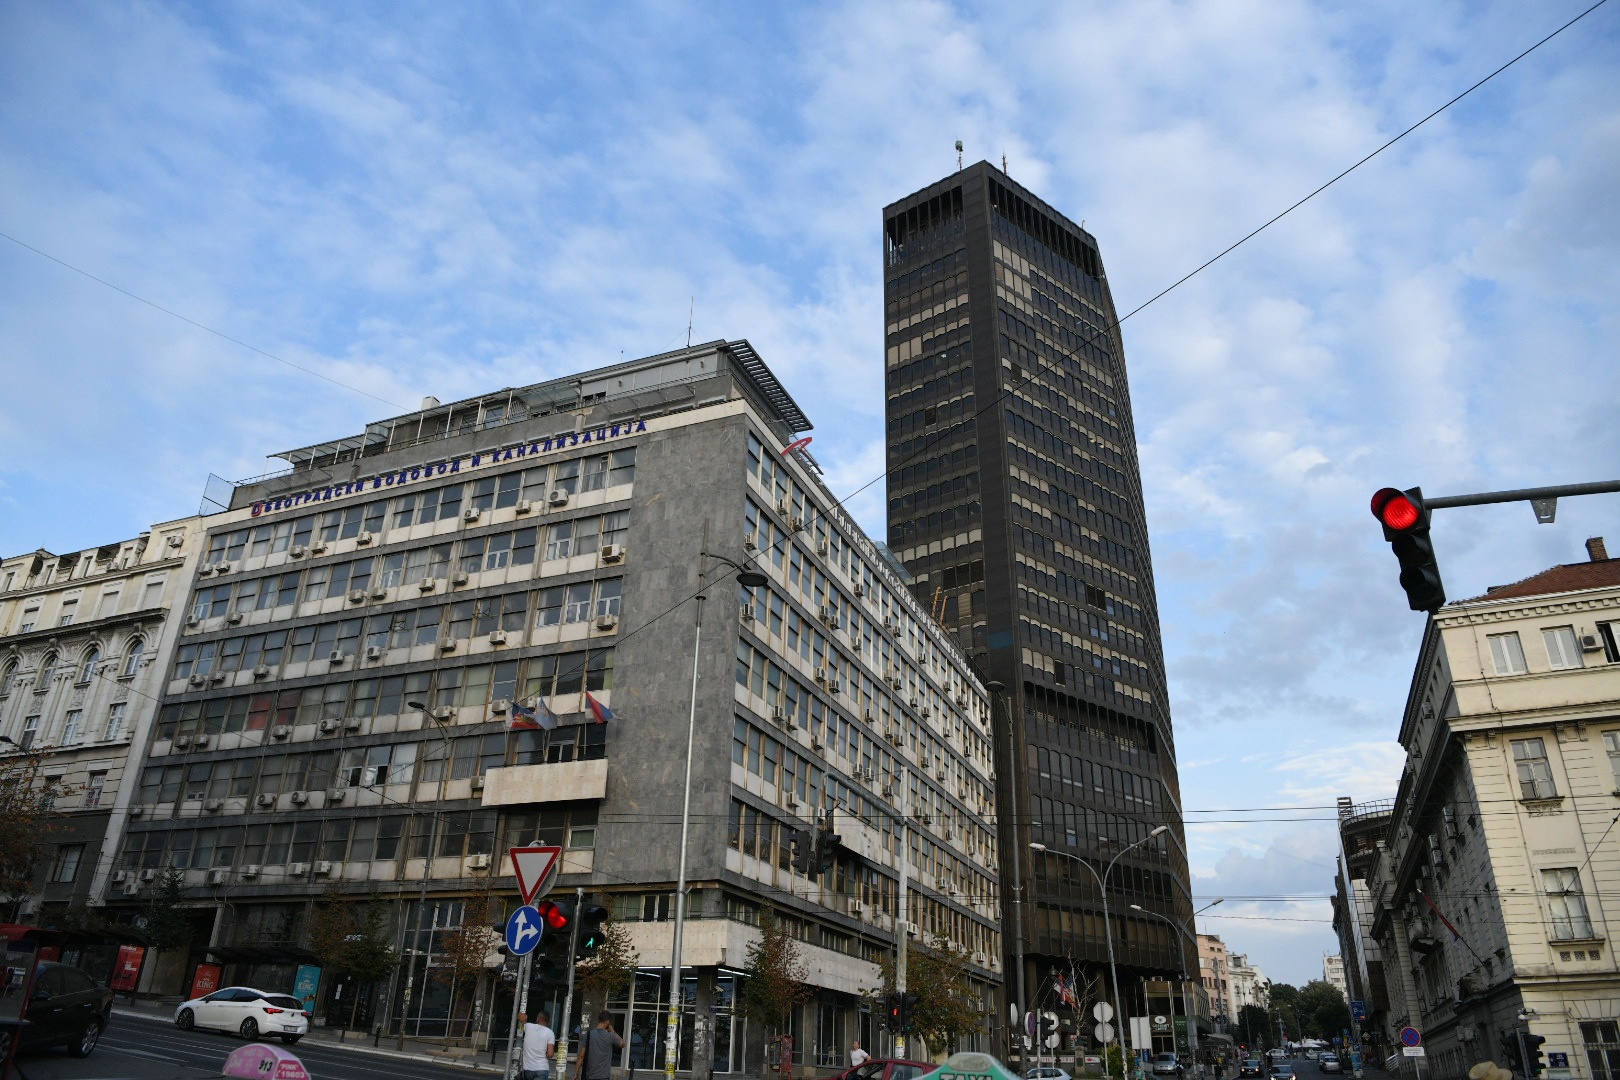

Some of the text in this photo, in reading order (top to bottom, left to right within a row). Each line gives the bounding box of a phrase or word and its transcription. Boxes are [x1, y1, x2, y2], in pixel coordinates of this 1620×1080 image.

[264, 419, 647, 512] БЕОГРАДСКИ ВОДОВОД И КАНАЛИЗАЦИЈА
[196, 980, 214, 989] KING
[297, 982, 314, 991] KING
[258, 1059, 273, 1072] 913
